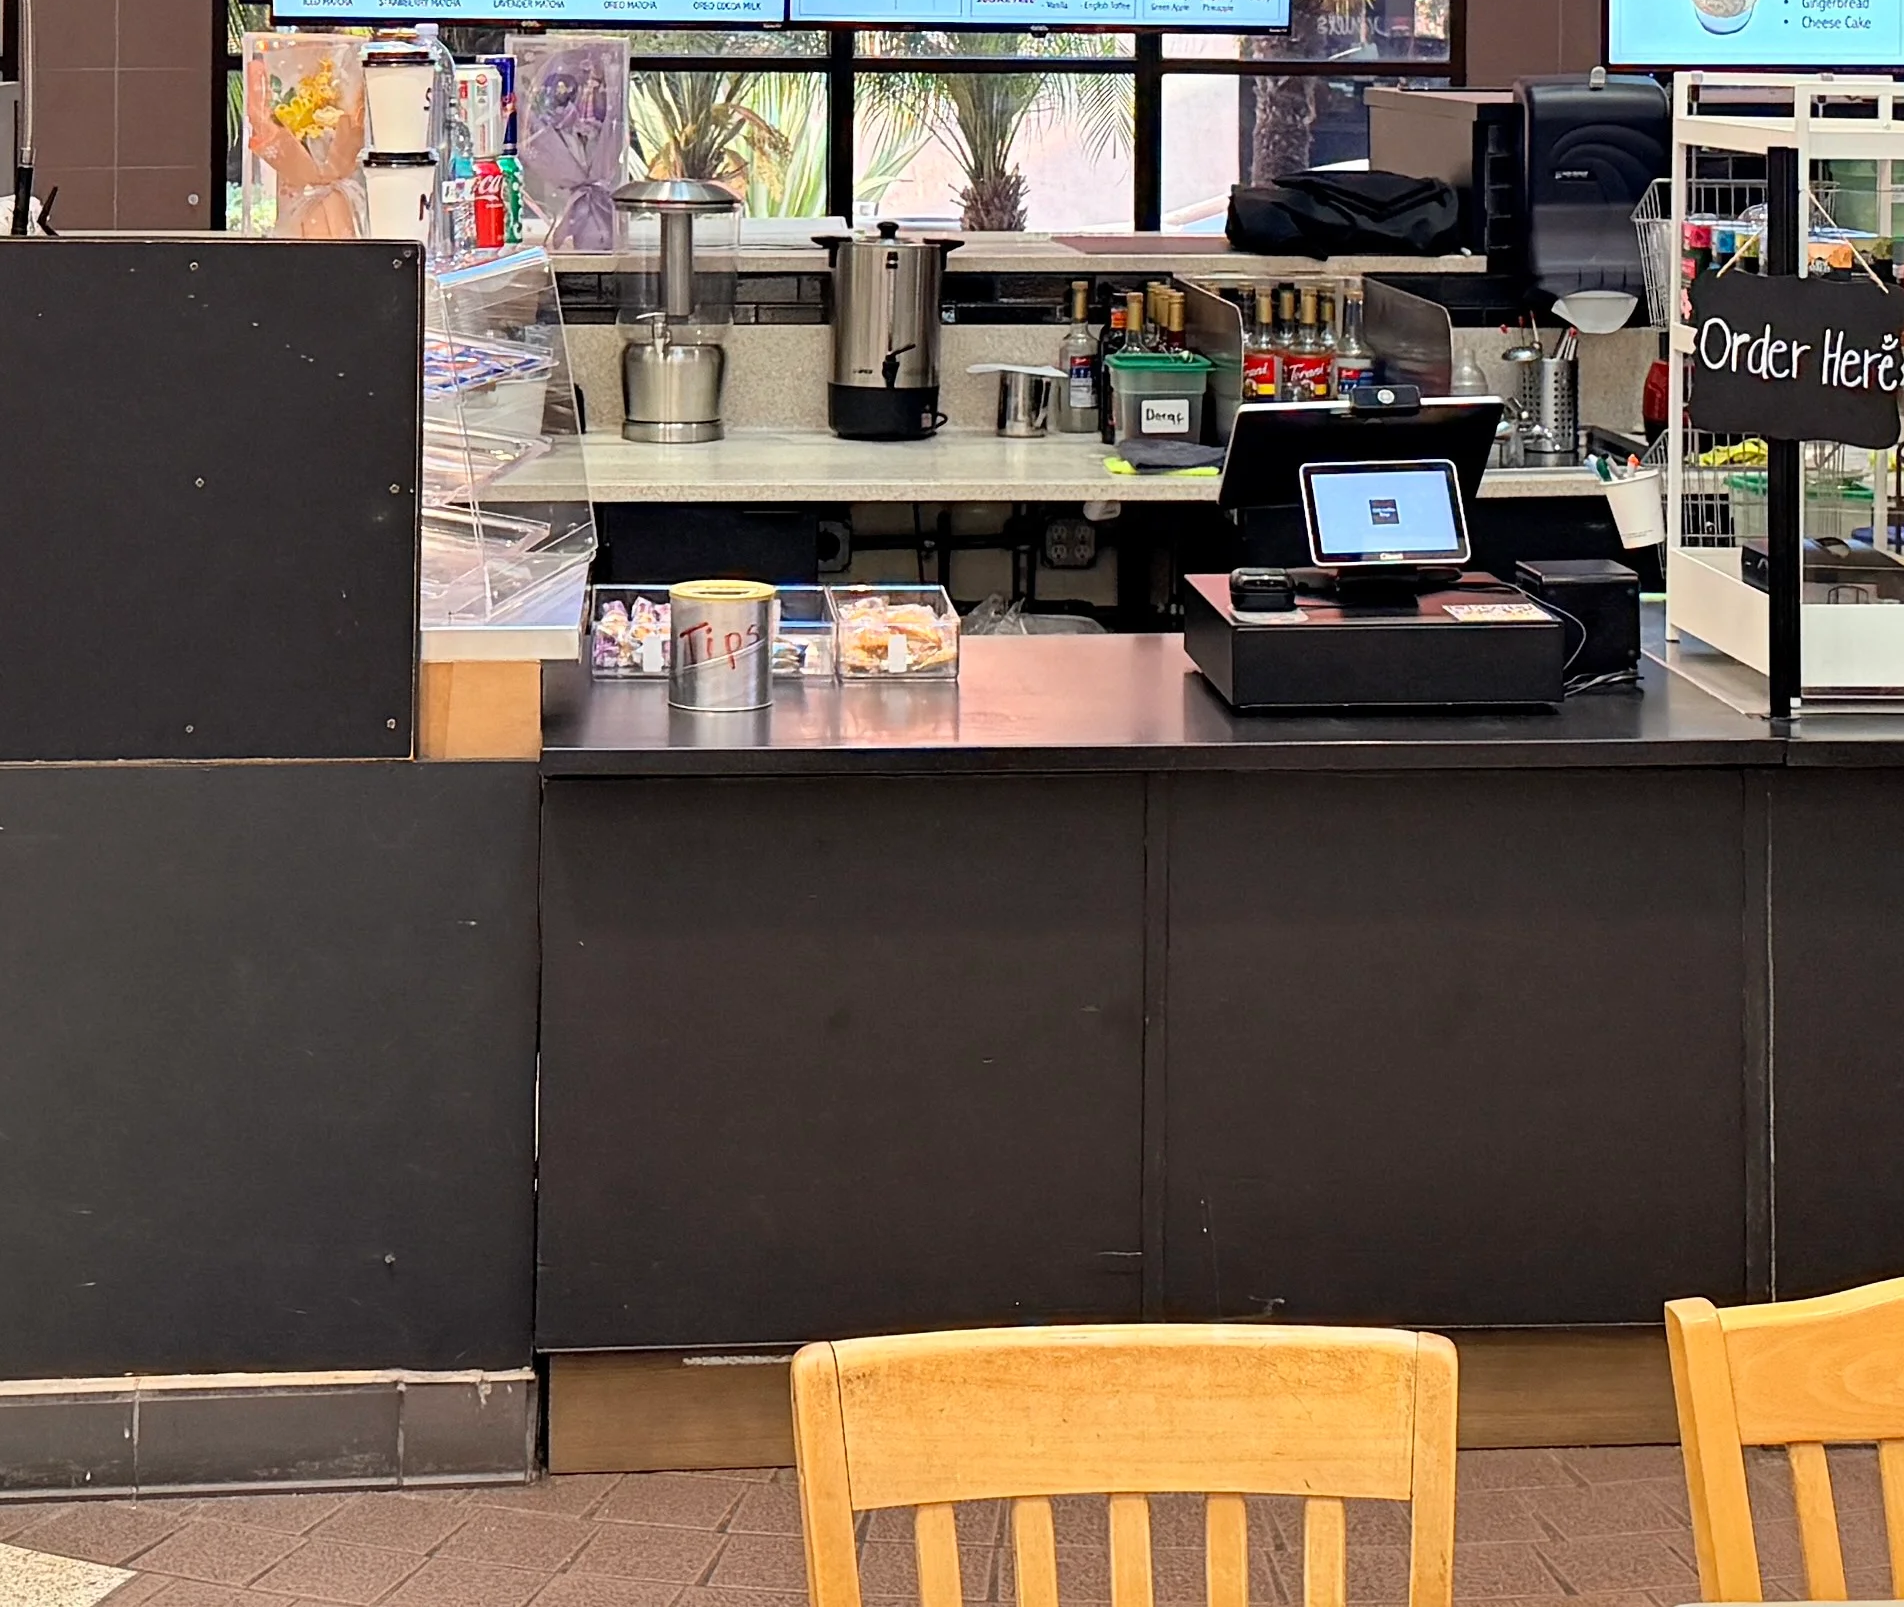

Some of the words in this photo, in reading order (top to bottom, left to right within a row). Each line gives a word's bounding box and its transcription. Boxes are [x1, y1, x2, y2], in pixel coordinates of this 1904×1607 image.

[1801, 15, 1841, 29] Cheese
[1845, 15, 1872, 29] Cake
[1700, 317, 1812, 380] Order
[1821, 328, 1899, 392] Here
[679, 621, 761, 670] Tips
